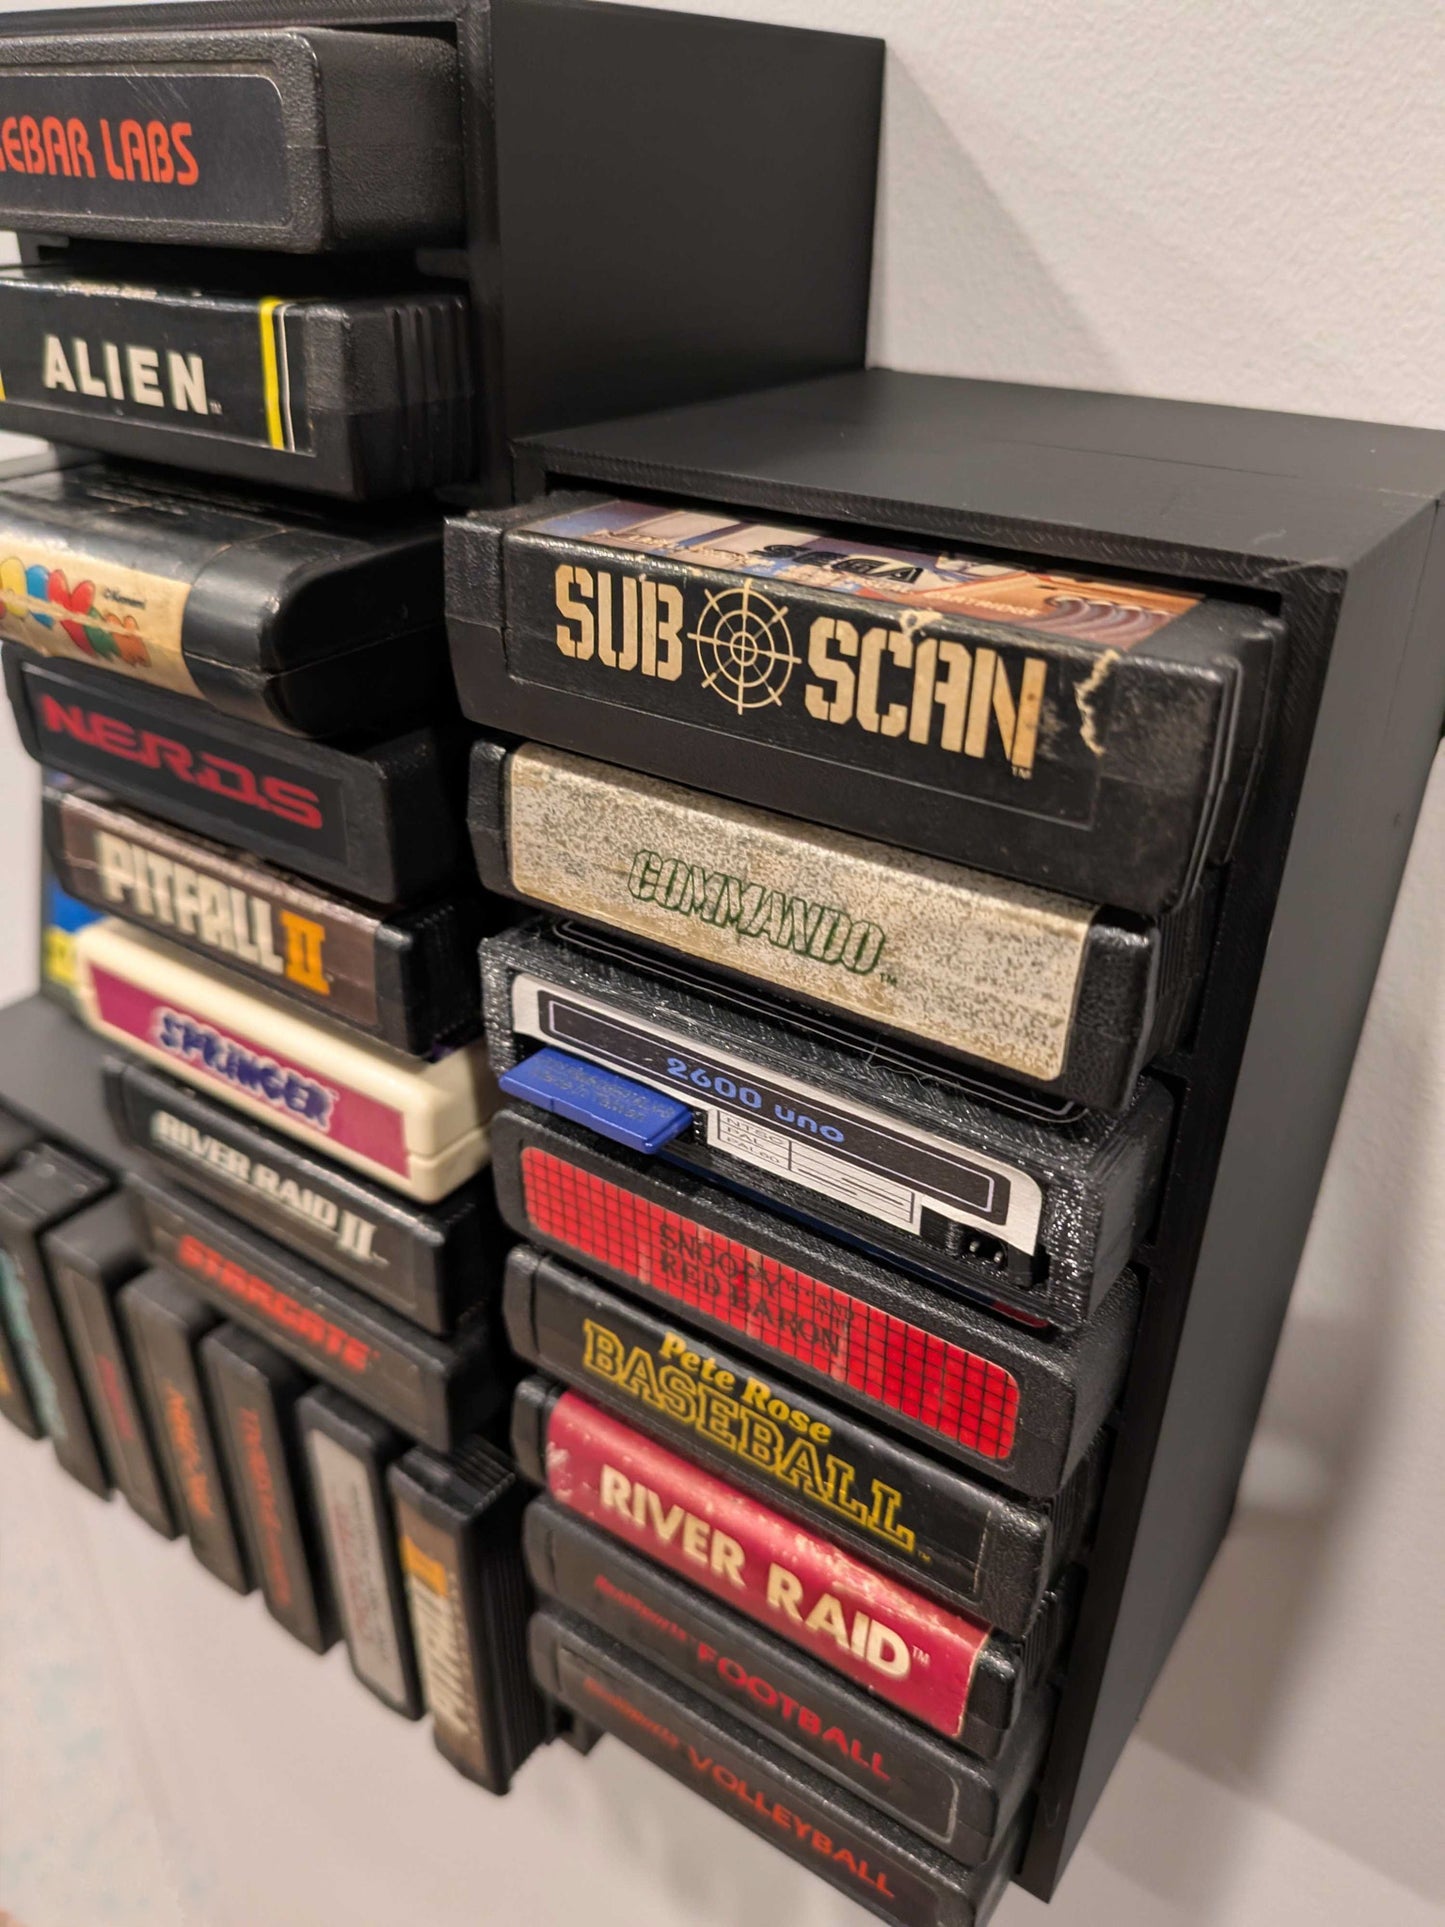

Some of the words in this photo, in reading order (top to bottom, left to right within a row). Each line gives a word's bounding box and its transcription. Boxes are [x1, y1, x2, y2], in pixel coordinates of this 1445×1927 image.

[0, 115, 96, 178] EBAR
[99, 118, 199, 186] LABS
[43, 335, 208, 415] ALIEN
[748, 544, 924, 585] SEGA
[555, 564, 683, 682] SUB
[804, 616, 1047, 769] SCAN
[41, 694, 322, 829] NERDS
[95, 831, 283, 975] PITFALL
[281, 909, 330, 996] II
[628, 850, 886, 975] COMMANDO
[155, 1008, 334, 1130] SPRINGER
[667, 1057, 761, 1109] 2600
[774, 1104, 845, 1143] uno
[153, 1109, 251, 1183] RIVER
[252, 1163, 338, 1229] RAID
[338, 1208, 377, 1263] II
[726, 1117, 784, 1146] NTSC
[726, 1127, 765, 1147] PAL
[659, 1223, 784, 1298] SNOOPY
[660, 1250, 722, 1298] RED
[730, 1284, 840, 1357] BARON
[583, 1318, 916, 1552] BASEBALL
[659, 1331, 735, 1392] Pete
[744, 1376, 832, 1445] Rose
[601, 1463, 746, 1588] RIVER
[767, 1562, 912, 1681] RAID
[697, 1641, 891, 1782] FOOTBALL
[686, 1743, 896, 1900] VOLLEYBALL
